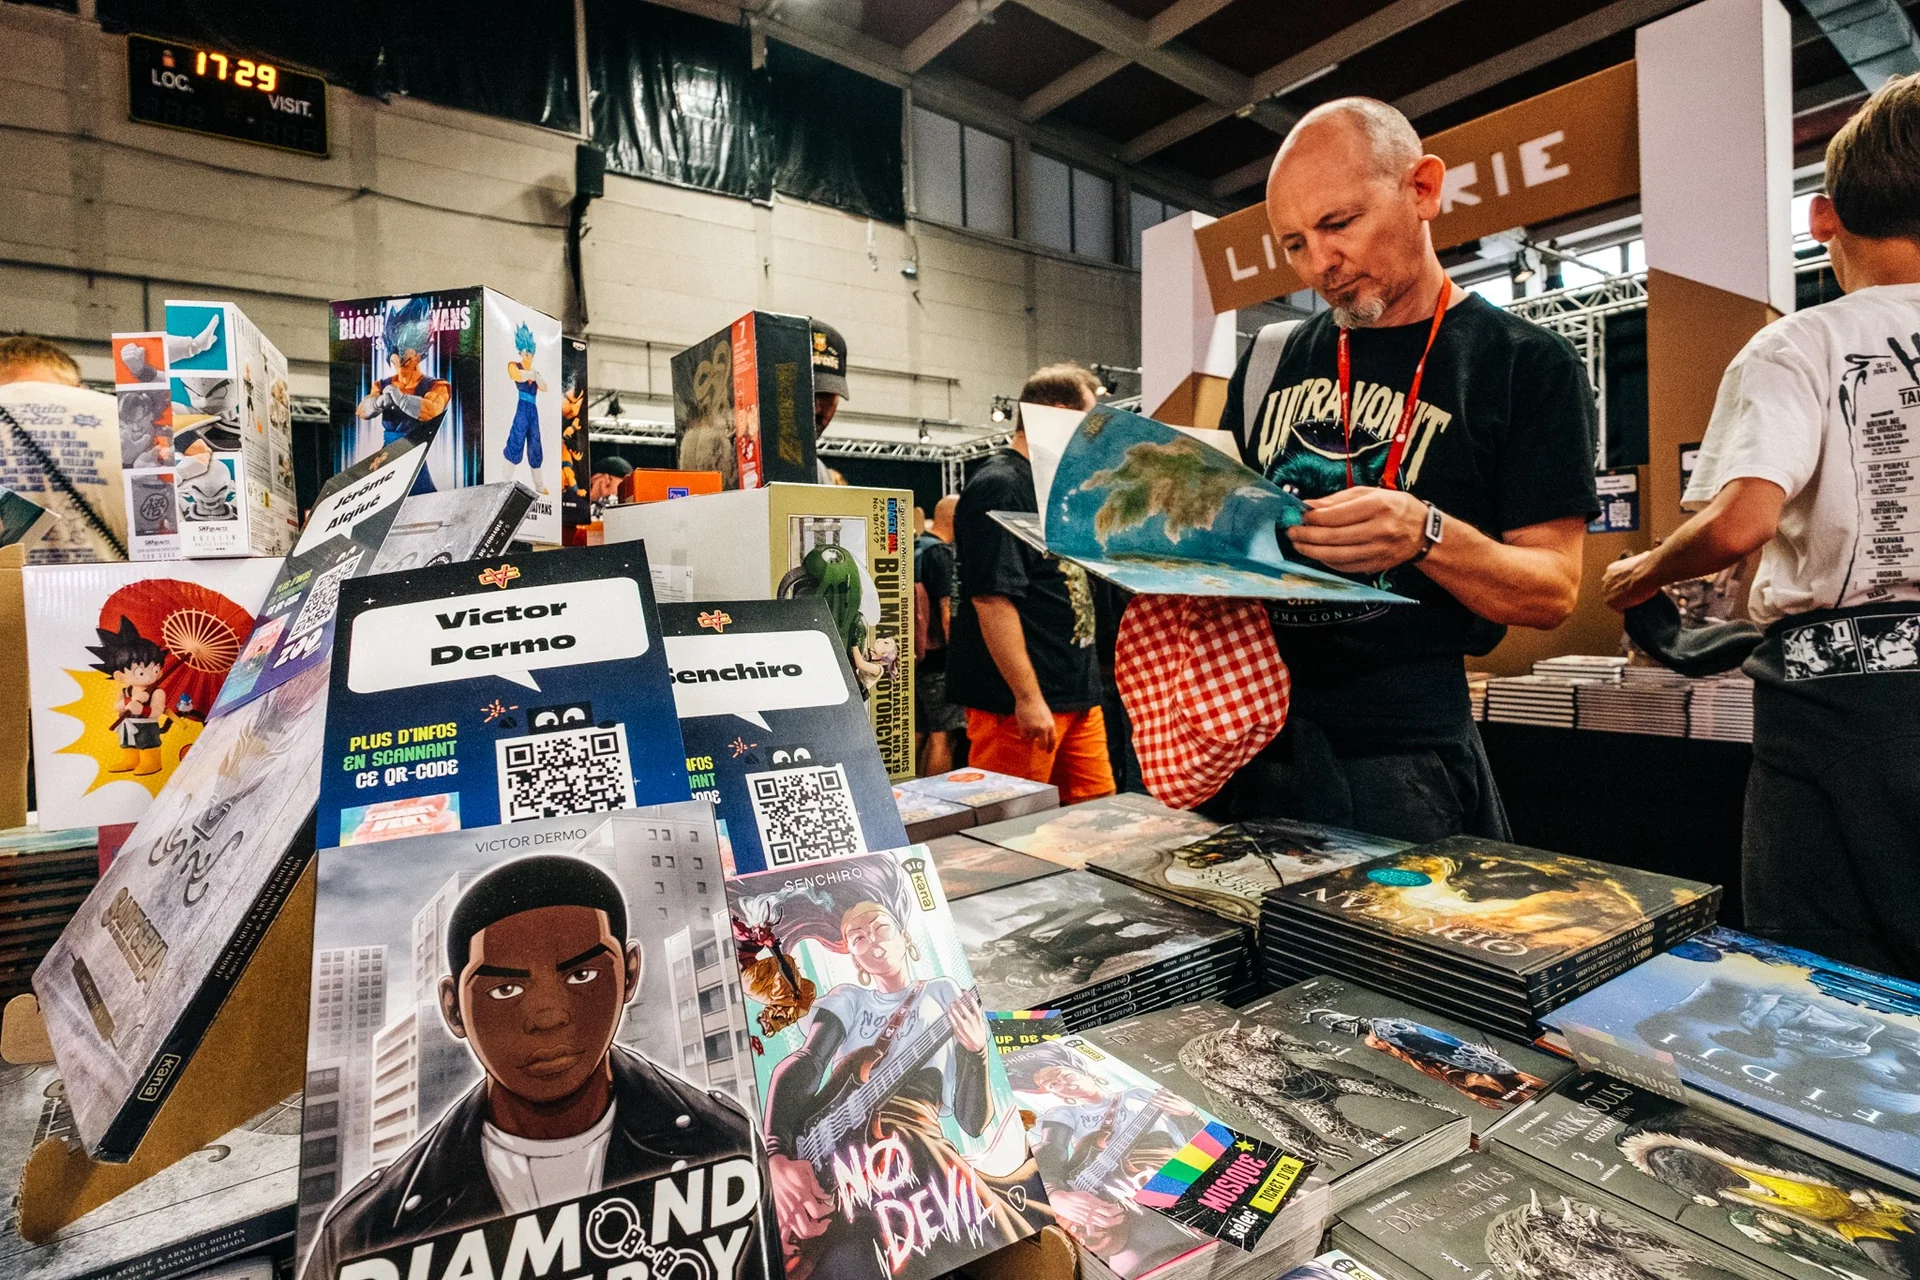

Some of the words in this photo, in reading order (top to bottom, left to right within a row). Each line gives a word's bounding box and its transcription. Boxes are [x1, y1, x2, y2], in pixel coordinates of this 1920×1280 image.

[151, 68, 195, 93] LOC.
[268, 94, 314, 118] VISIT.
[339, 315, 385, 340] BLOOD
[529, 502, 552, 516] AIYANS
[435, 602, 567, 631] Victor
[901, 597, 909, 635] DRAGON
[430, 633, 577, 666] Dermo
[901, 637, 909, 659] BALL
[901, 660, 909, 718] FIGURE-RISE
[349, 731, 392, 752] PLUS
[398, 722, 457, 746] D'INFOS
[901, 718, 909, 772] MECHANICS
[343, 752, 370, 772] EN
[373, 740, 457, 766] SCANNANT
[355, 770, 378, 789] CE
[384, 759, 459, 787] QR-CODE
[475, 835, 530, 853] VICTOR
[534, 829, 587, 847] DERMO
[784, 867, 863, 893] SENCHIRO
[904, 862, 924, 872] BIG
[914, 874, 932, 908] kana
[995, 1035, 1010, 1044] UP
[1002, 1052, 1036, 1067] CHIRO
[144, 1058, 175, 1096] kana
[1198, 1153, 1268, 1214] MUSIQUE
[1259, 1179, 1284, 1203] TICKET
[1281, 1163, 1299, 1181] D'OR
[167, 1241, 207, 1260] ARNAUD
